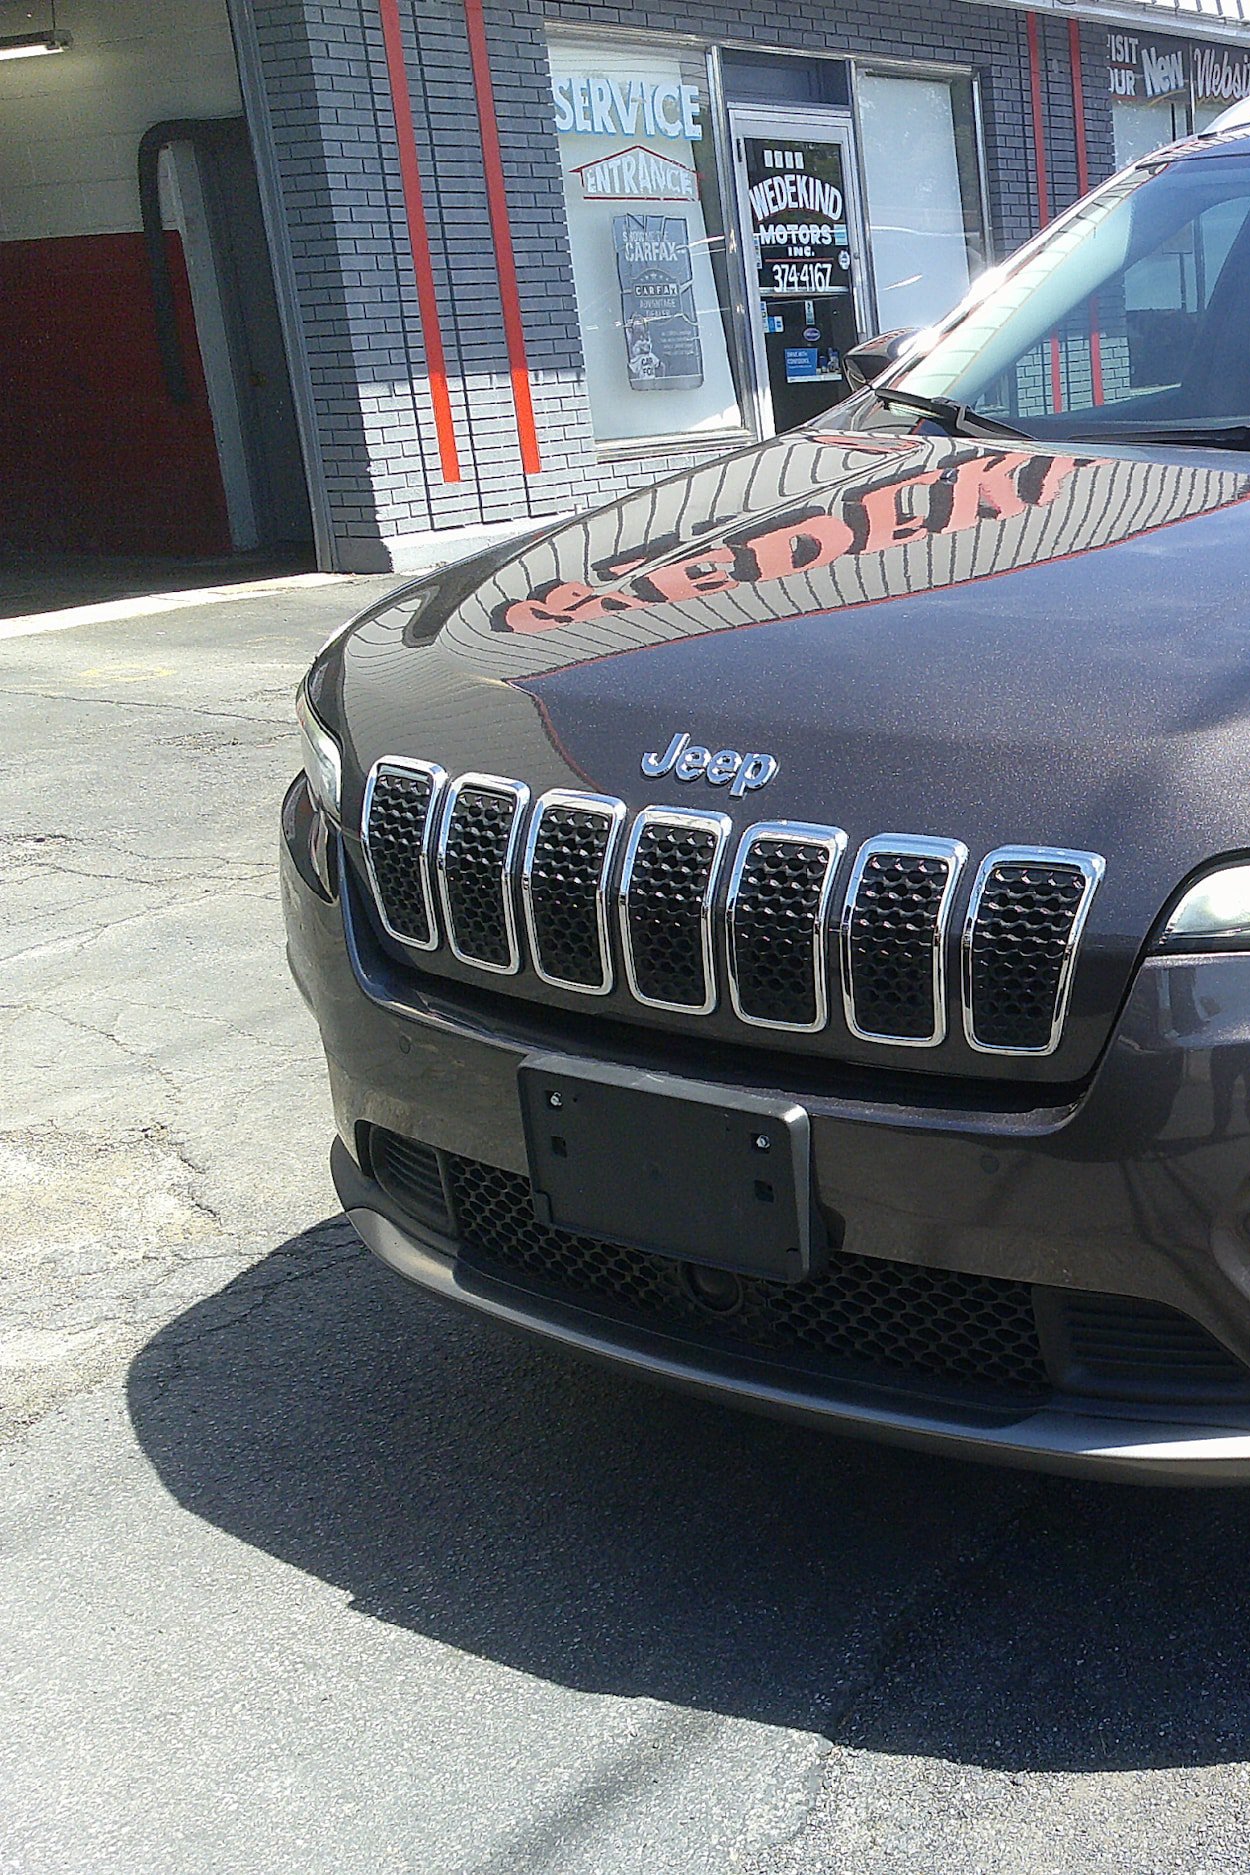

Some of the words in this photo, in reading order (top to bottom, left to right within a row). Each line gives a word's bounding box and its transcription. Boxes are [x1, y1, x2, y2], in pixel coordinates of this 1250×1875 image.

[1141, 46, 1185, 98] New
[551, 77, 703, 141] SERVICE
[586, 152, 693, 195] ENTRANCE
[749, 174, 843, 221] WEDEKIND
[624, 241, 678, 262] CARFAX
[758, 224, 833, 245] MOTORS
[635, 285, 678, 297] CARFAX
[772, 263, 833, 292] 374-4167
[641, 732, 779, 799] Jeep
